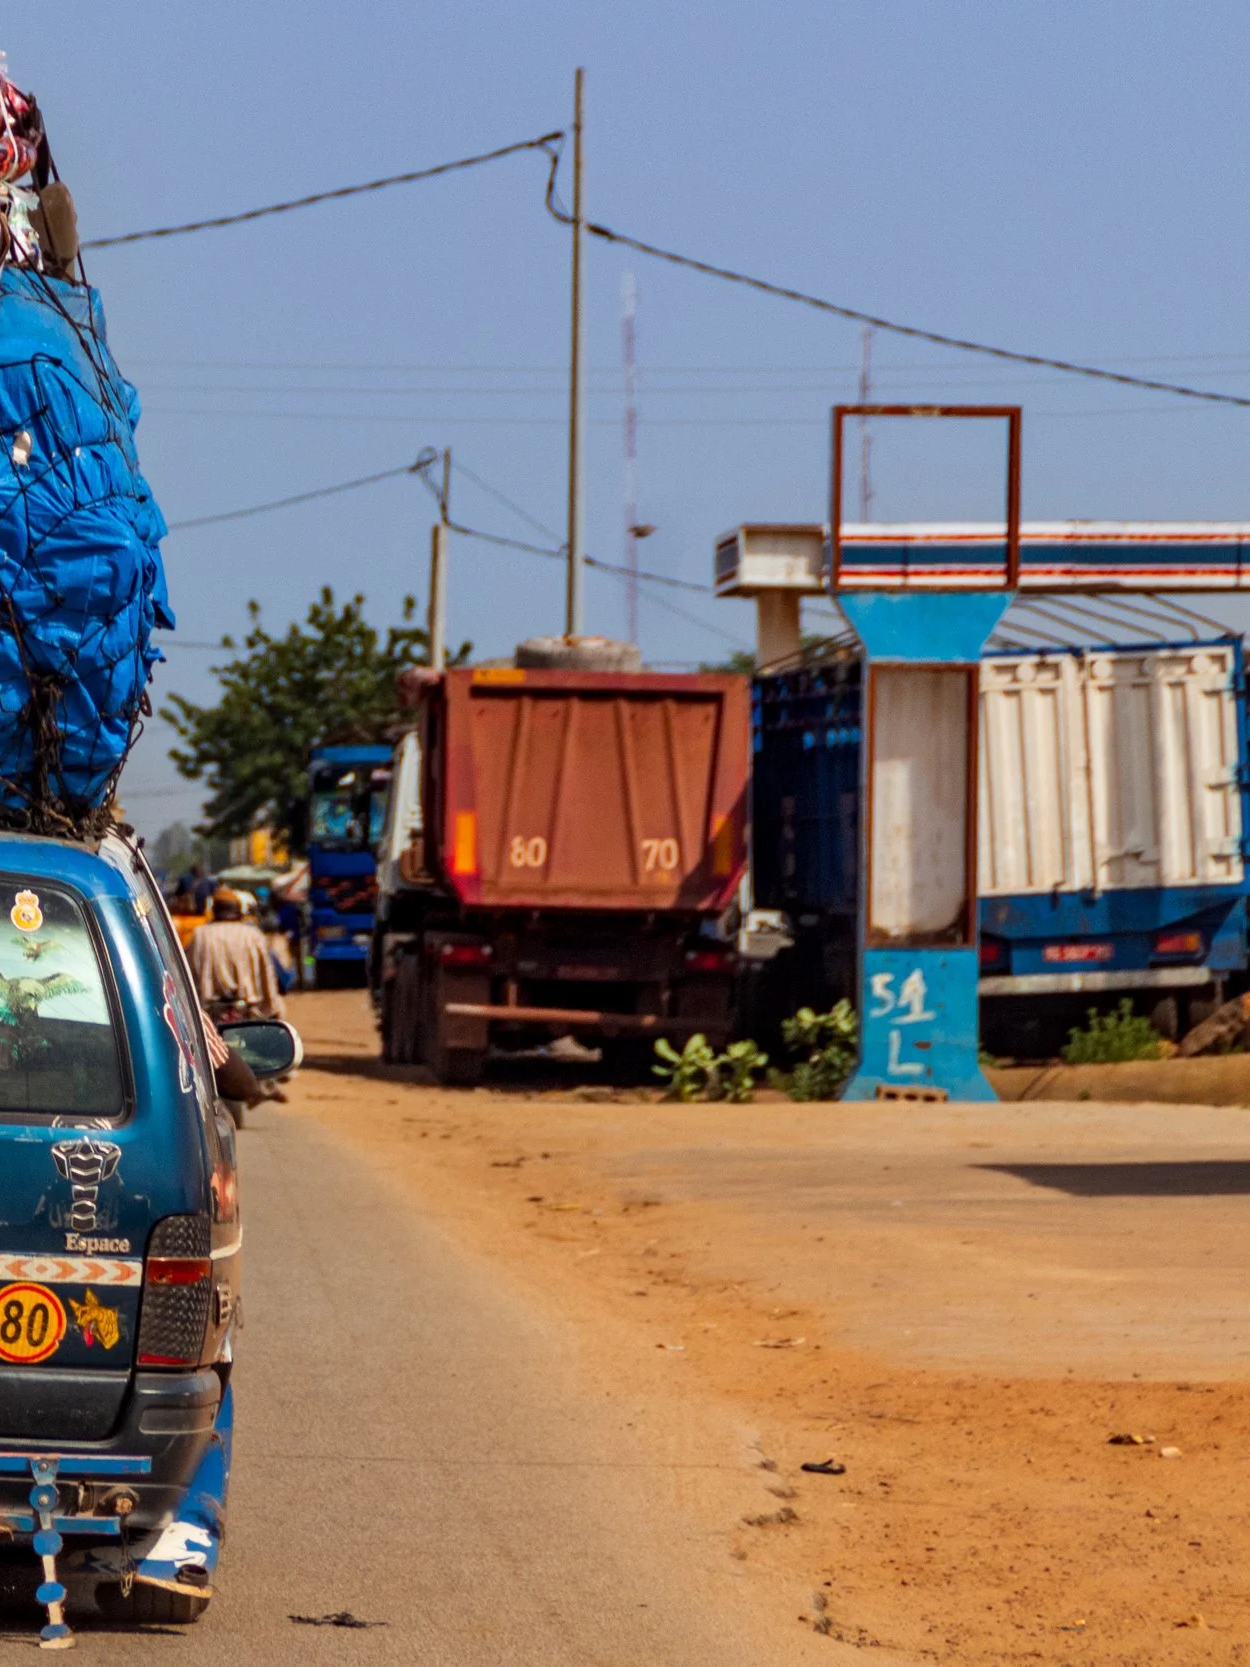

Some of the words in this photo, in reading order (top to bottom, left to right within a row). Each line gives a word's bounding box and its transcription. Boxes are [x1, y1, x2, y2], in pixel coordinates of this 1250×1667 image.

[642, 838, 679, 871] 70
[64, 1233, 131, 1254] Espace
[0, 1300, 50, 1347] 80
